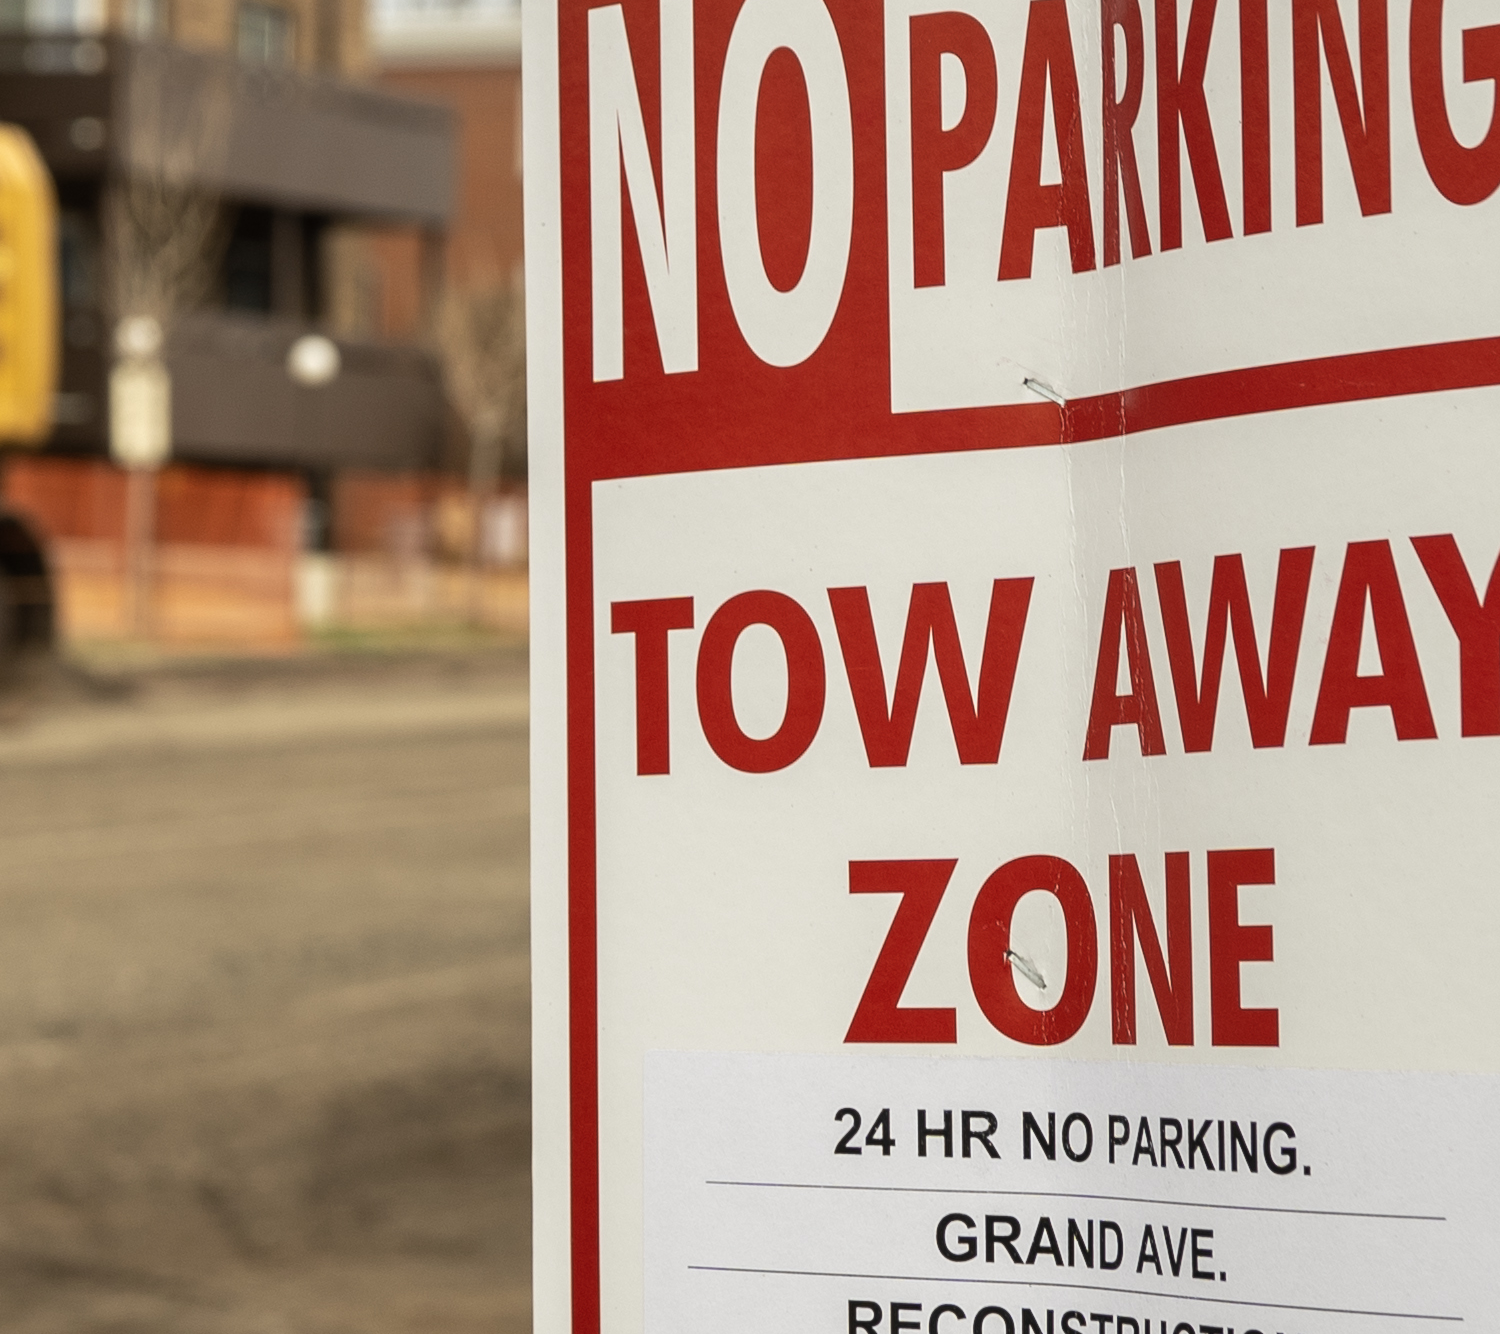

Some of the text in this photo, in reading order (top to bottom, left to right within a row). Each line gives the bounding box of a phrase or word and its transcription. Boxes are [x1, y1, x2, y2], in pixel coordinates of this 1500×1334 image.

[611, 577, 1034, 776] TOW
[844, 848, 1279, 1047] ZONE
[834, 1108, 1310, 1175] 24 HR NO PARKING.
[936, 1213, 1226, 1281] GRAND AVE.
